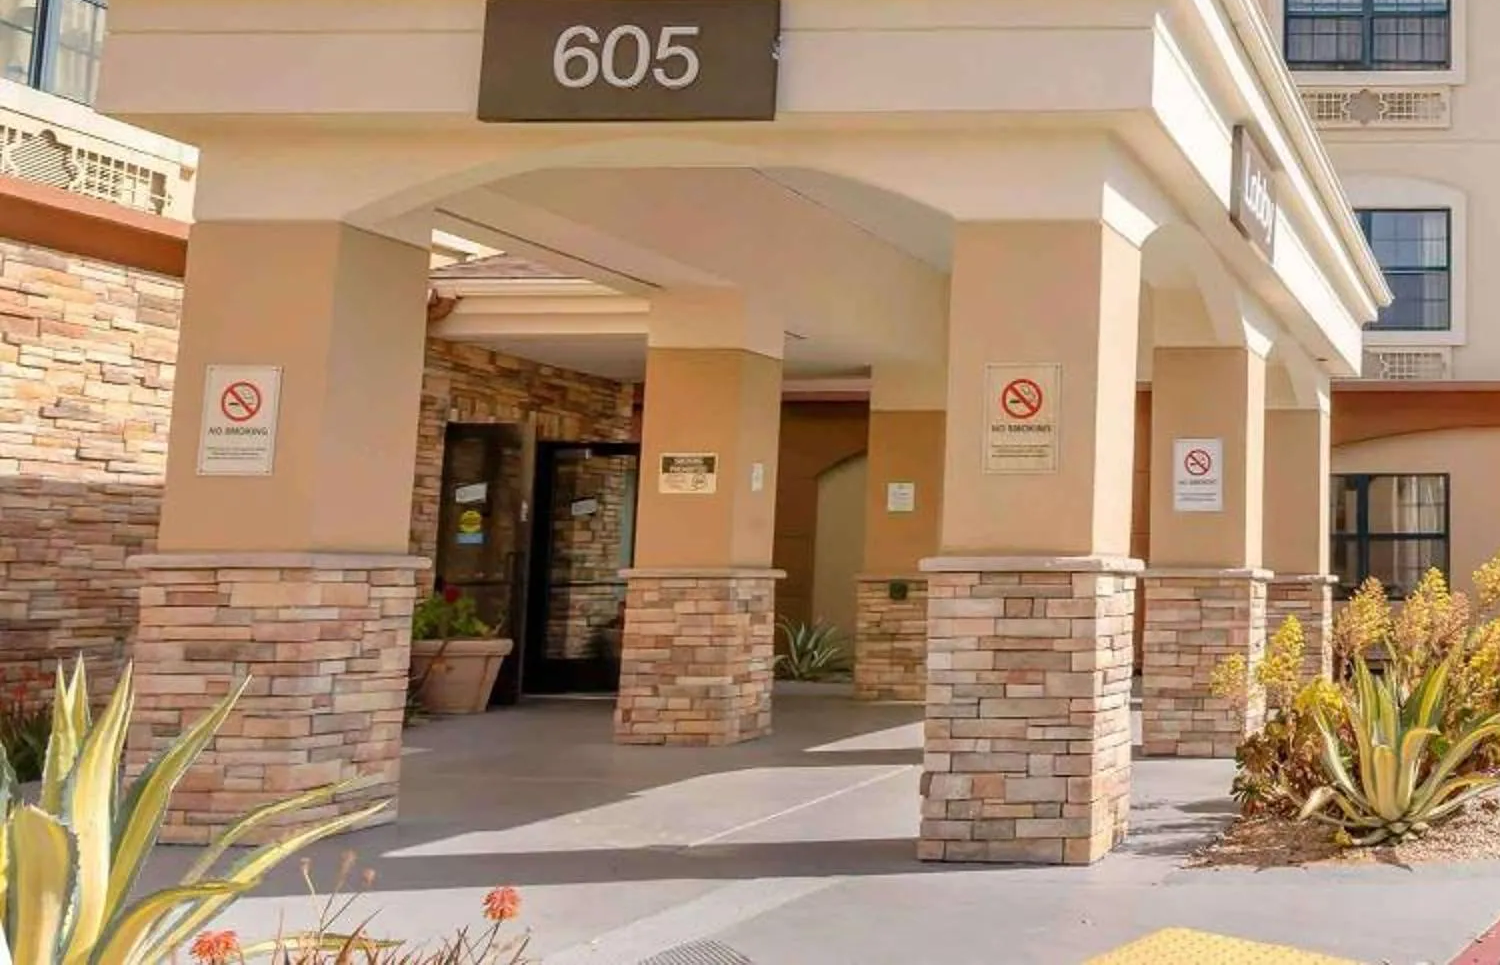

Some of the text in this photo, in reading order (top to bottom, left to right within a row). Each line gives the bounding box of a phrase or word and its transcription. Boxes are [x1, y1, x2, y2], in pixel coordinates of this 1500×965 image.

[553, 24, 700, 88] 605
[1245, 151, 1275, 245] Lobby
[207, 426, 269, 436] NO SMOKING
